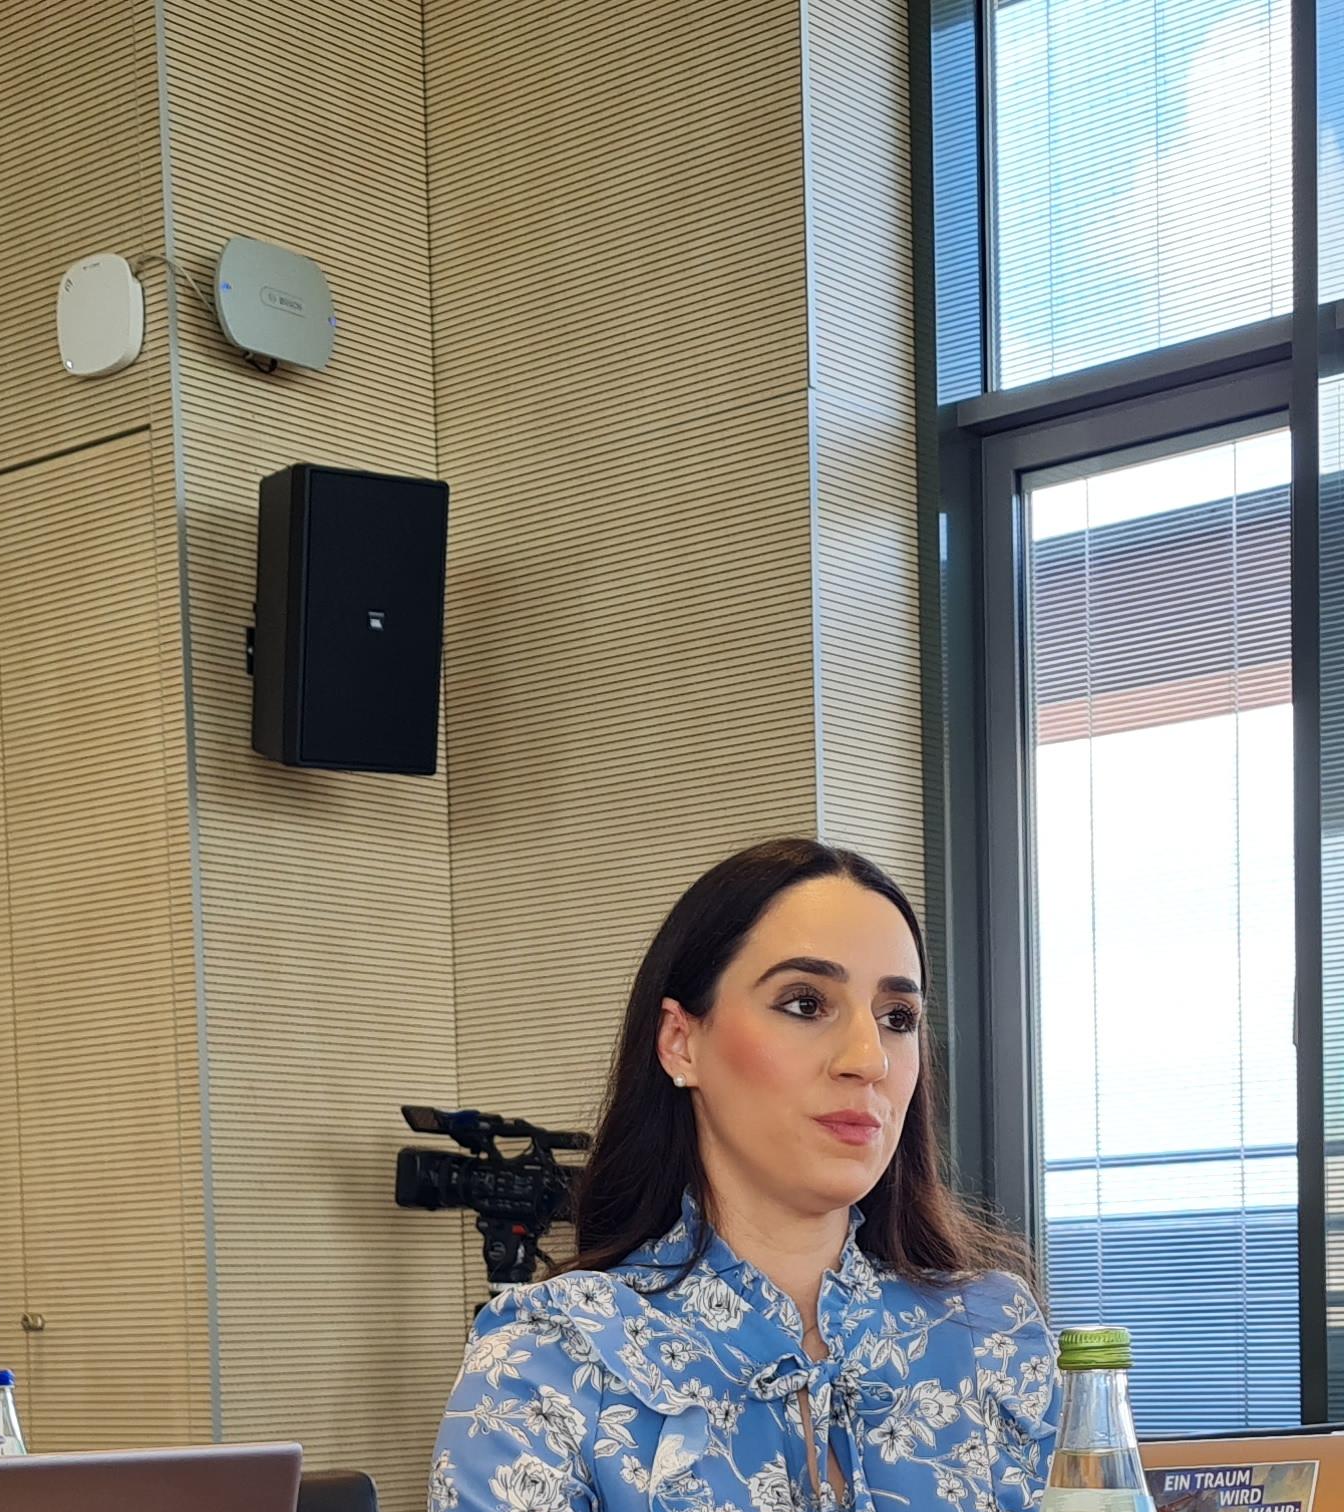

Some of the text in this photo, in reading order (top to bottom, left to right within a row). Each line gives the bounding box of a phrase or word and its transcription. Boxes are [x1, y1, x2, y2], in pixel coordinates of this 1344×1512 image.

[1164, 1470, 1251, 1491] EIN TRAUM
[1220, 1488, 1262, 1506] WIRD
